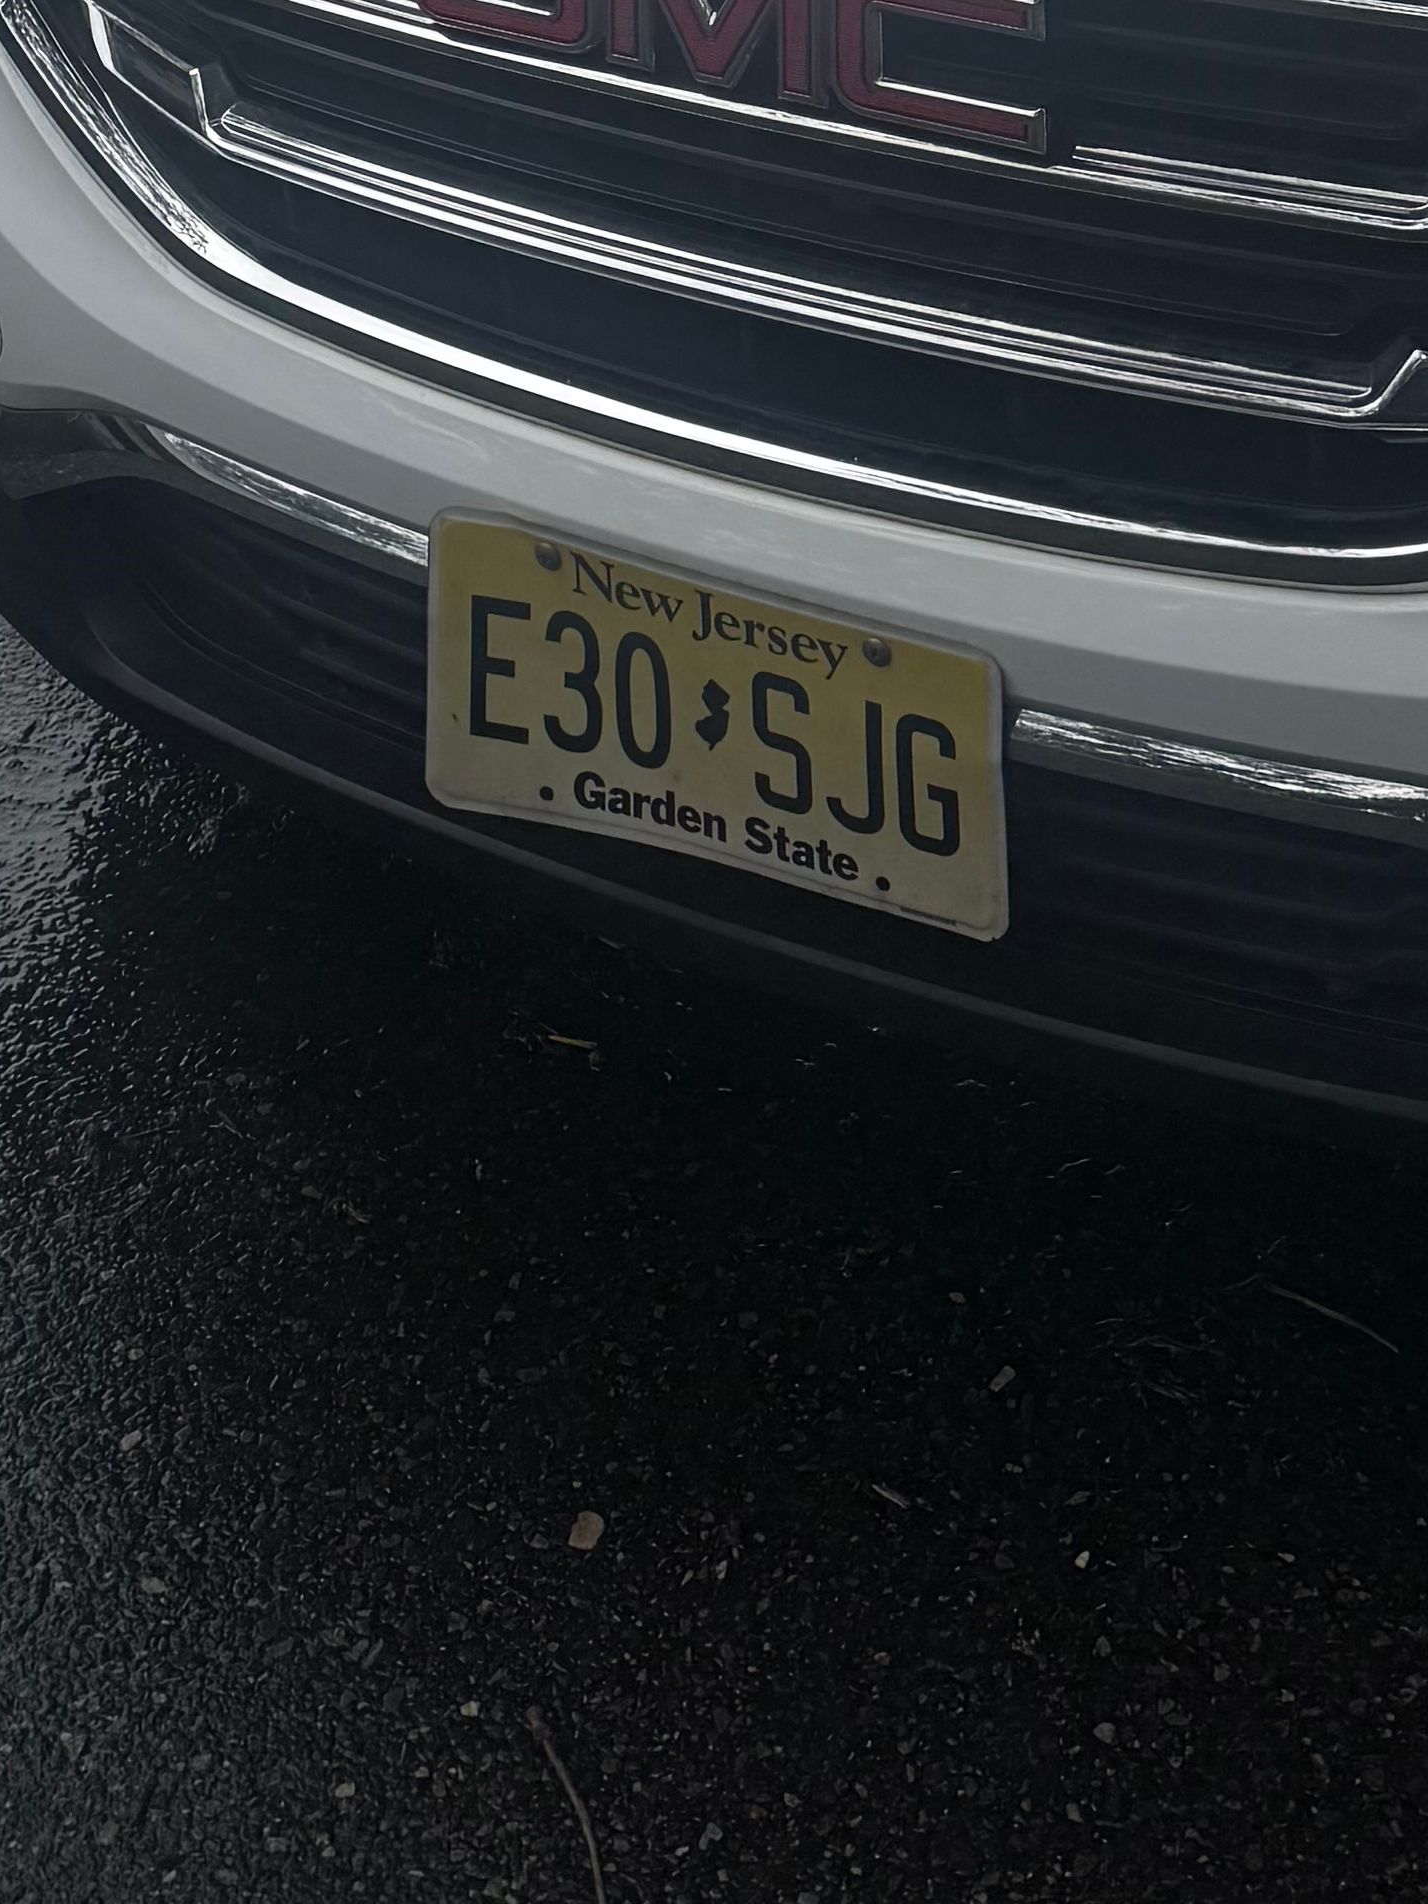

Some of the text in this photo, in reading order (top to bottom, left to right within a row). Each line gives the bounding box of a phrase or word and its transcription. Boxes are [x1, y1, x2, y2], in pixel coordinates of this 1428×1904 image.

[570, 551, 848, 680] New Jersey
[469, 593, 961, 857] E30 SJG
[573, 770, 860, 881] Garden State
